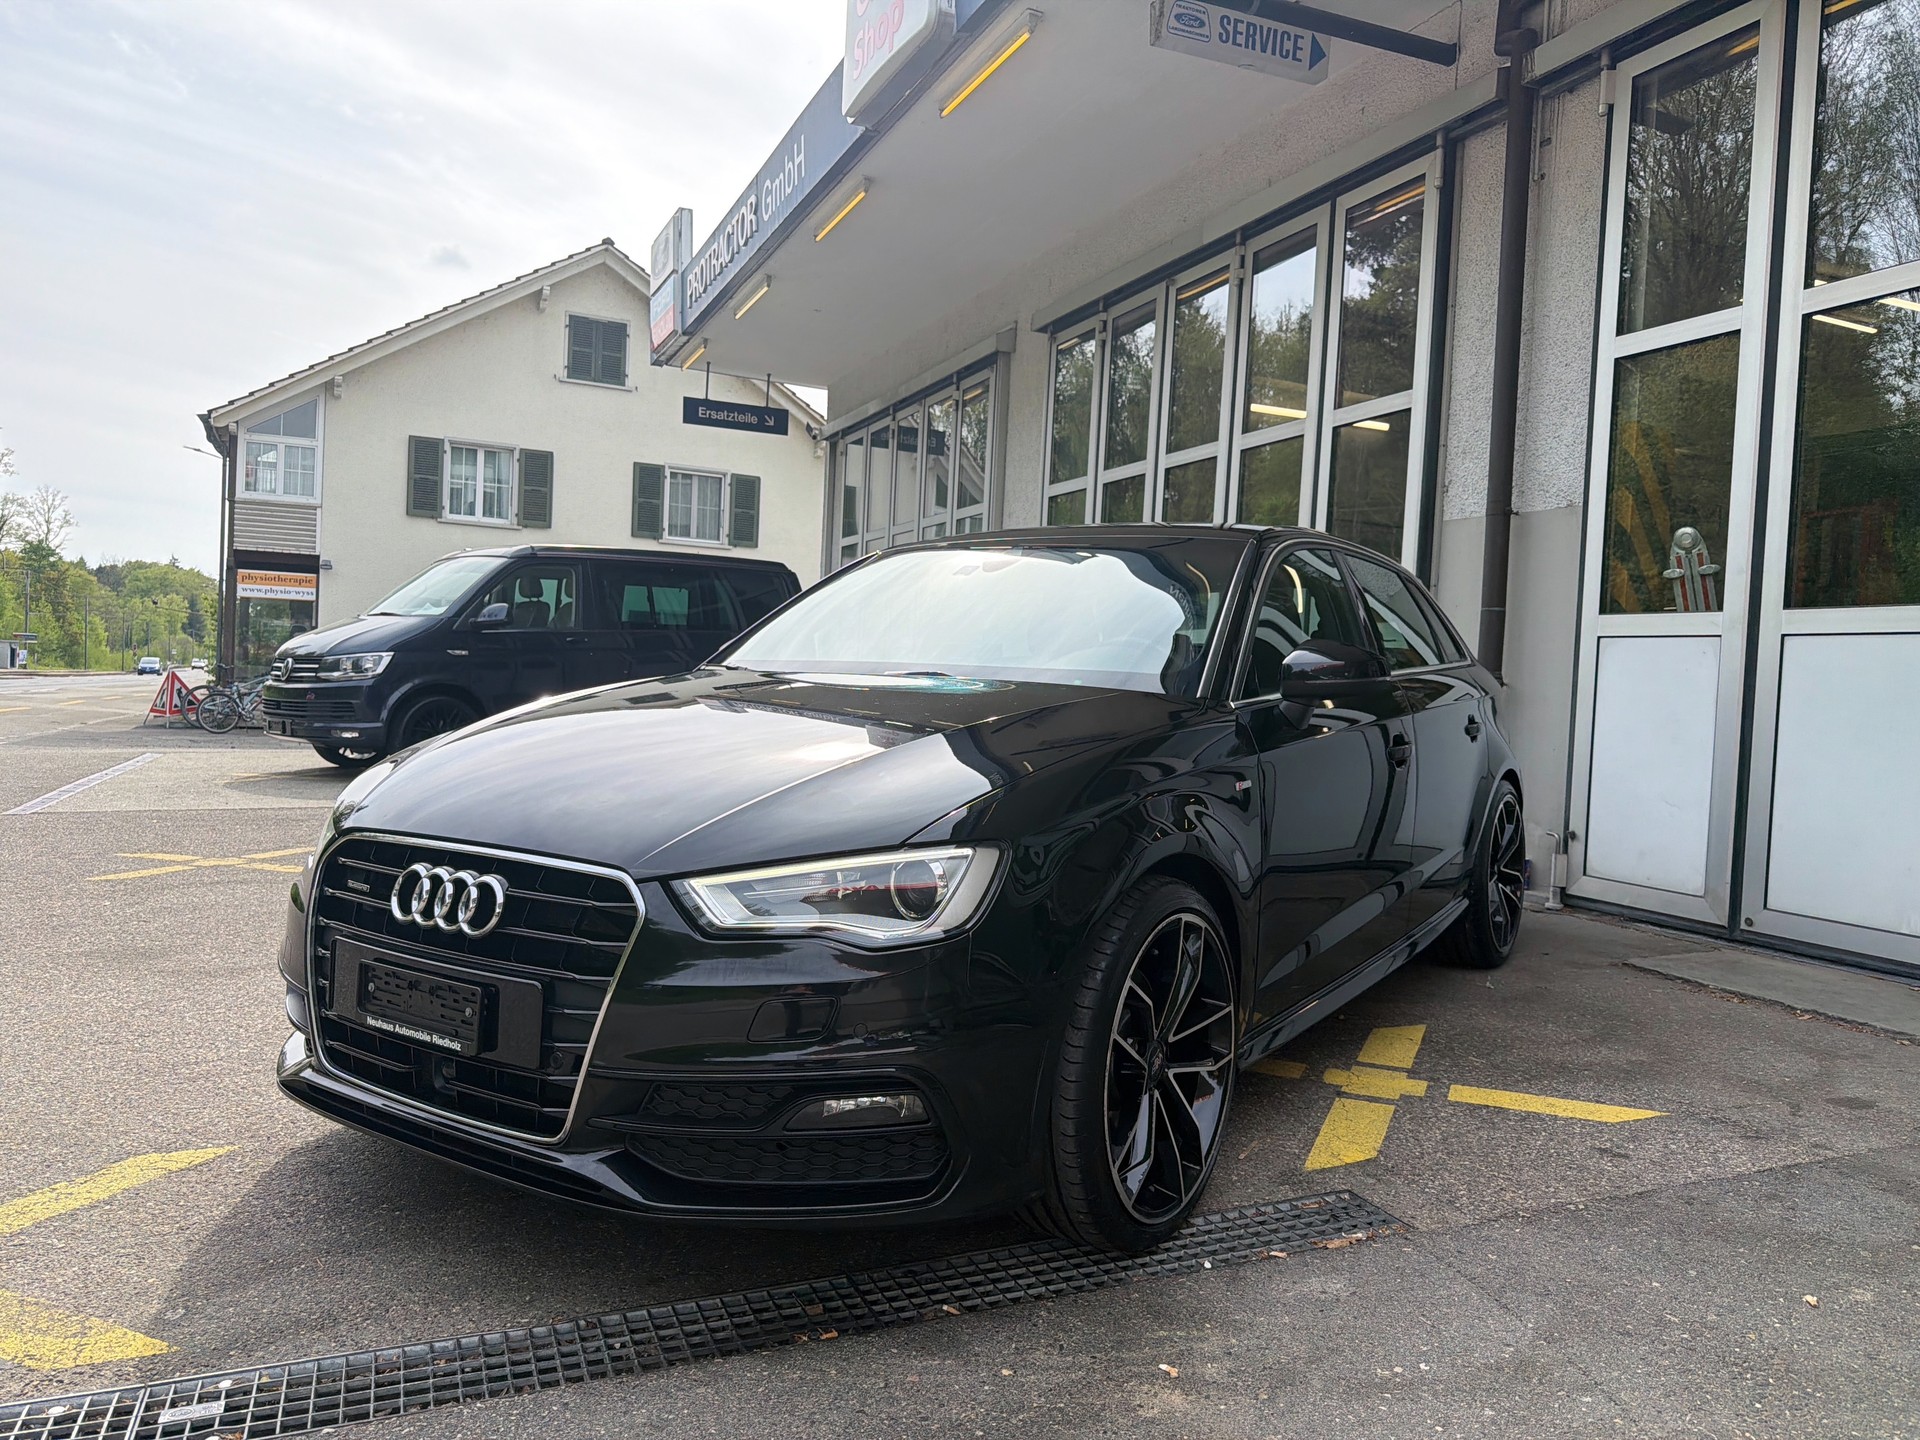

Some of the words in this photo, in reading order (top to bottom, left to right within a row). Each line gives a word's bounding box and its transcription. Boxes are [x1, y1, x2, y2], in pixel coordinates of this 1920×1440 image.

[1179, 14, 1201, 28] Ford
[1218, 14, 1305, 63] SERVICE
[687, 194, 758, 309] PROTRACTOR
[761, 133, 805, 222] GmbH
[698, 406, 758, 424] Ersatzteile
[241, 573, 313, 586] physiotherapie
[241, 587, 314, 597] www.physio-wyss
[366, 1015, 394, 1032] Neuhaus
[395, 1024, 431, 1042] Automobile
[432, 1034, 462, 1051] Riedholz
